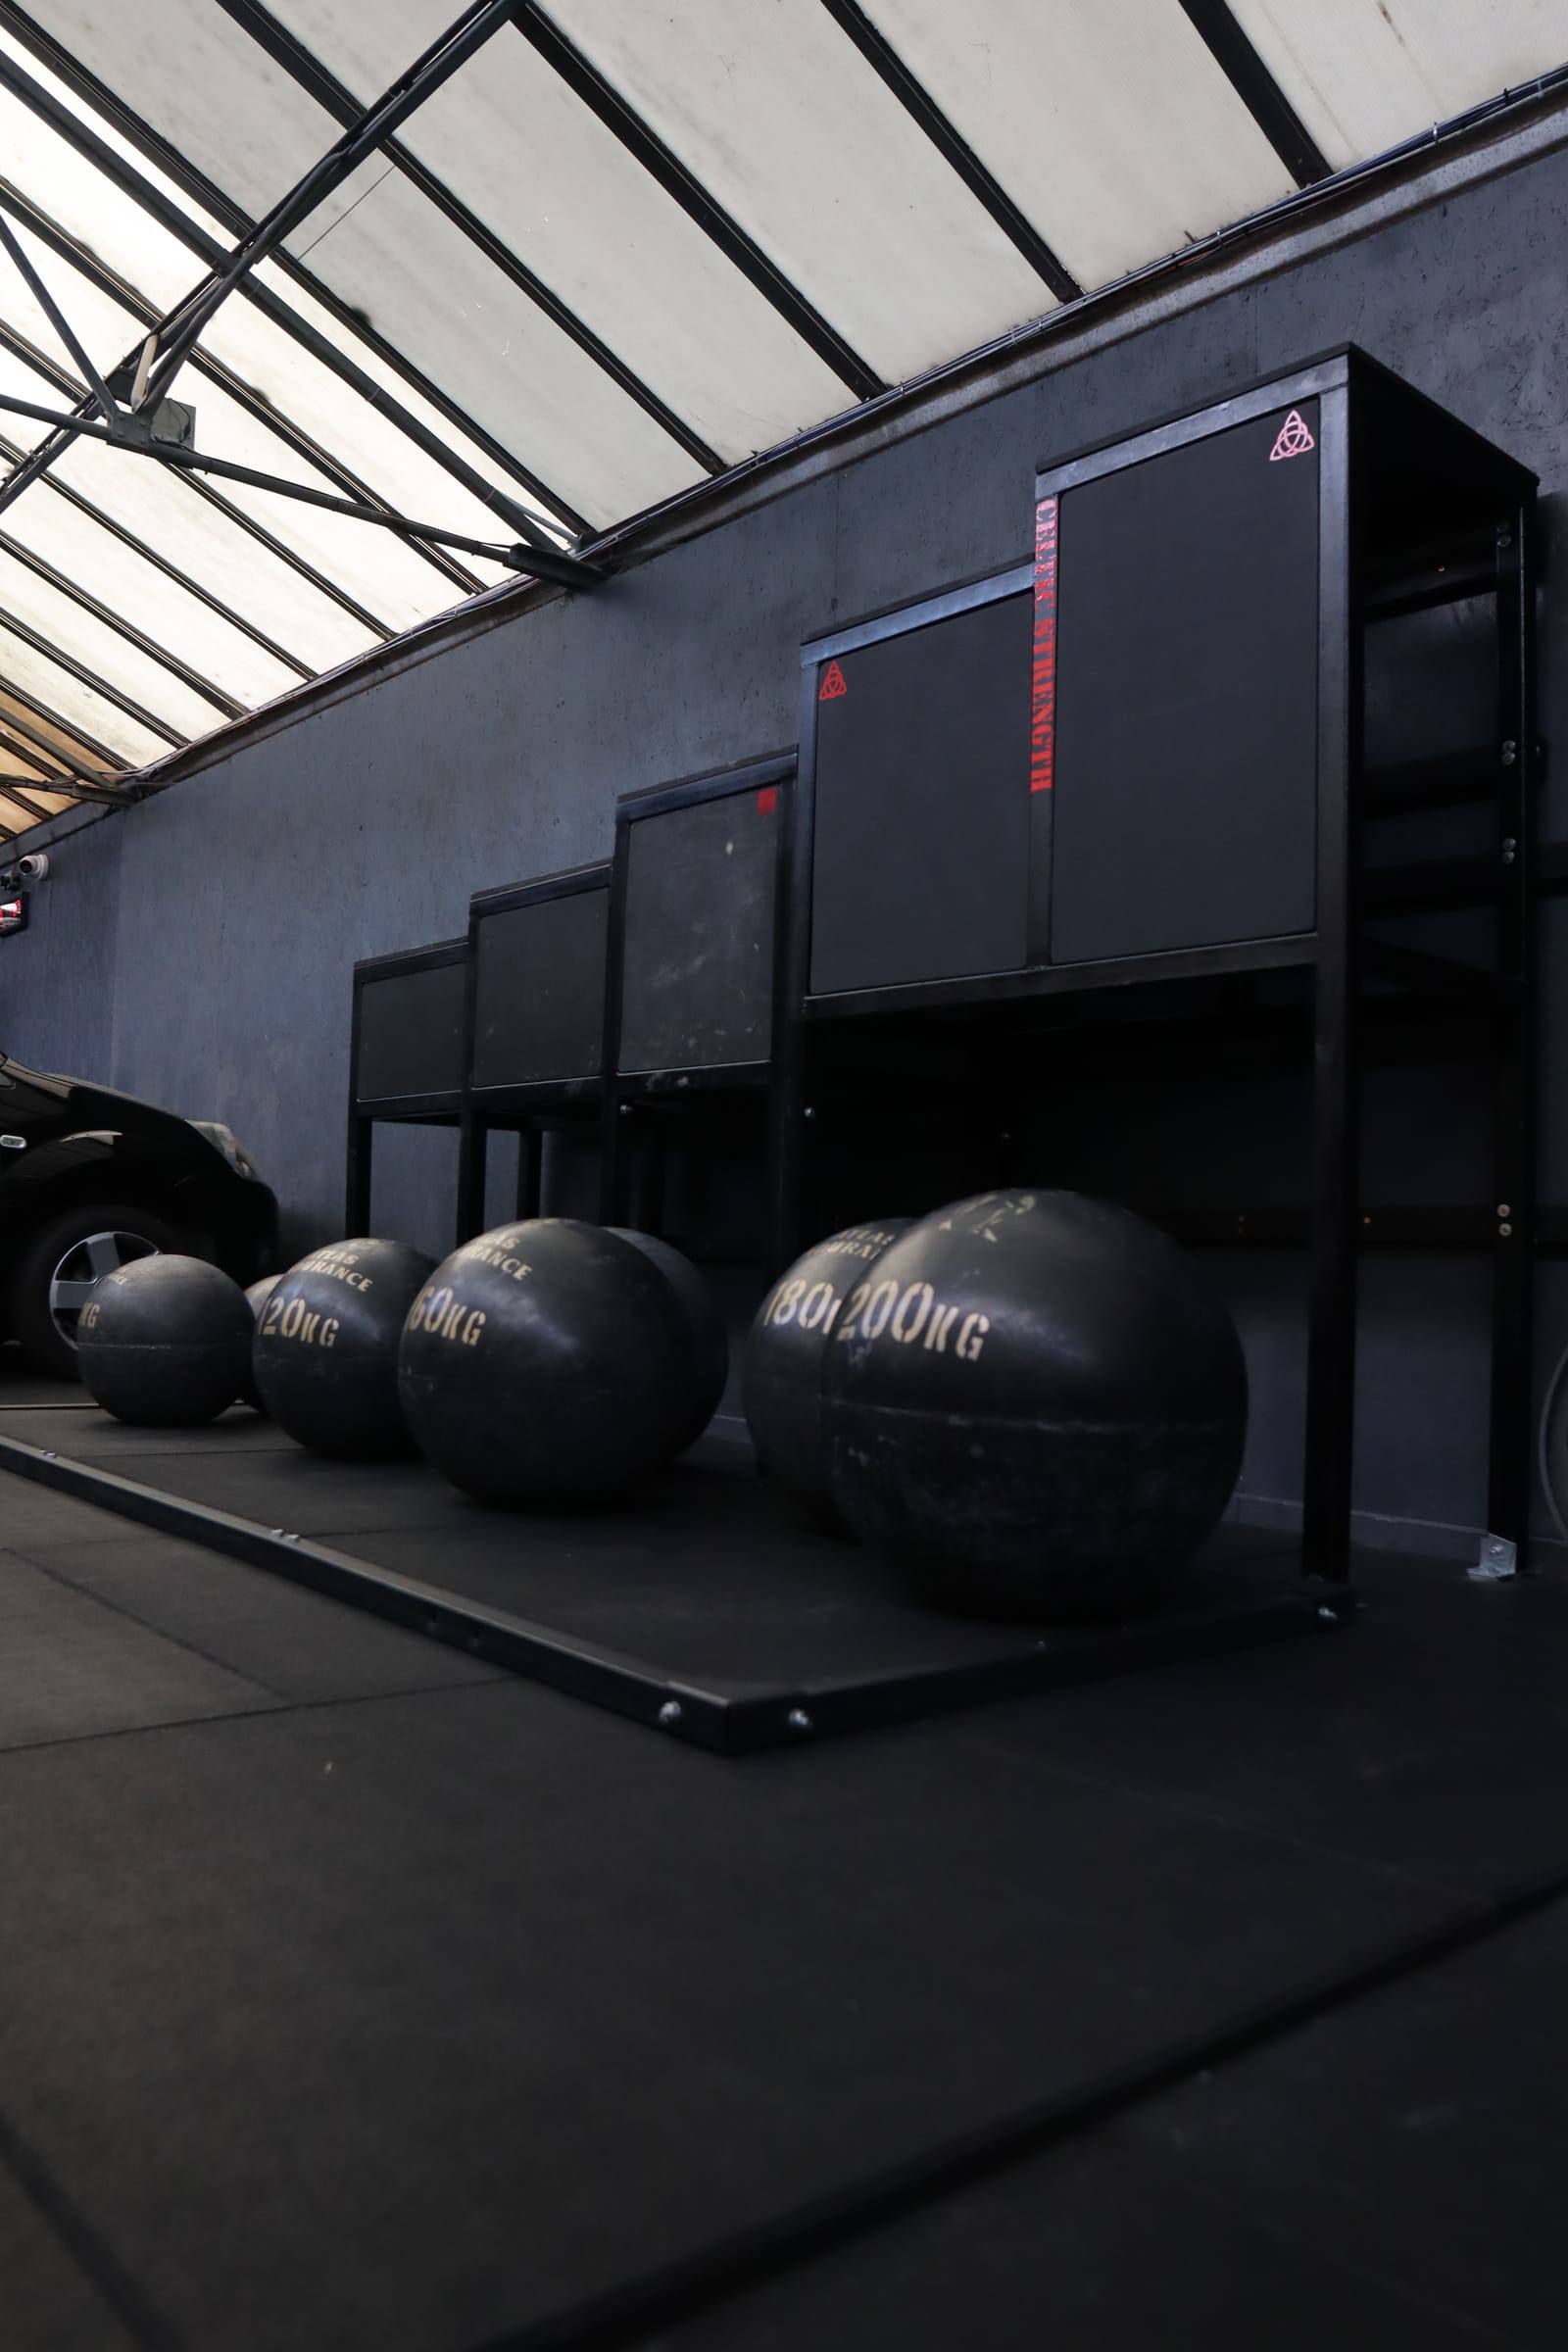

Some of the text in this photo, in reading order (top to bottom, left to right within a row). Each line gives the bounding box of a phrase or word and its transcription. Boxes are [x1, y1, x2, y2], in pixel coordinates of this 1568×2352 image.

[1029, 499, 1058, 793] CELTIC STRENGTH
[258, 1296, 340, 1348] 120KG
[837, 1280, 990, 1362] 200KG
